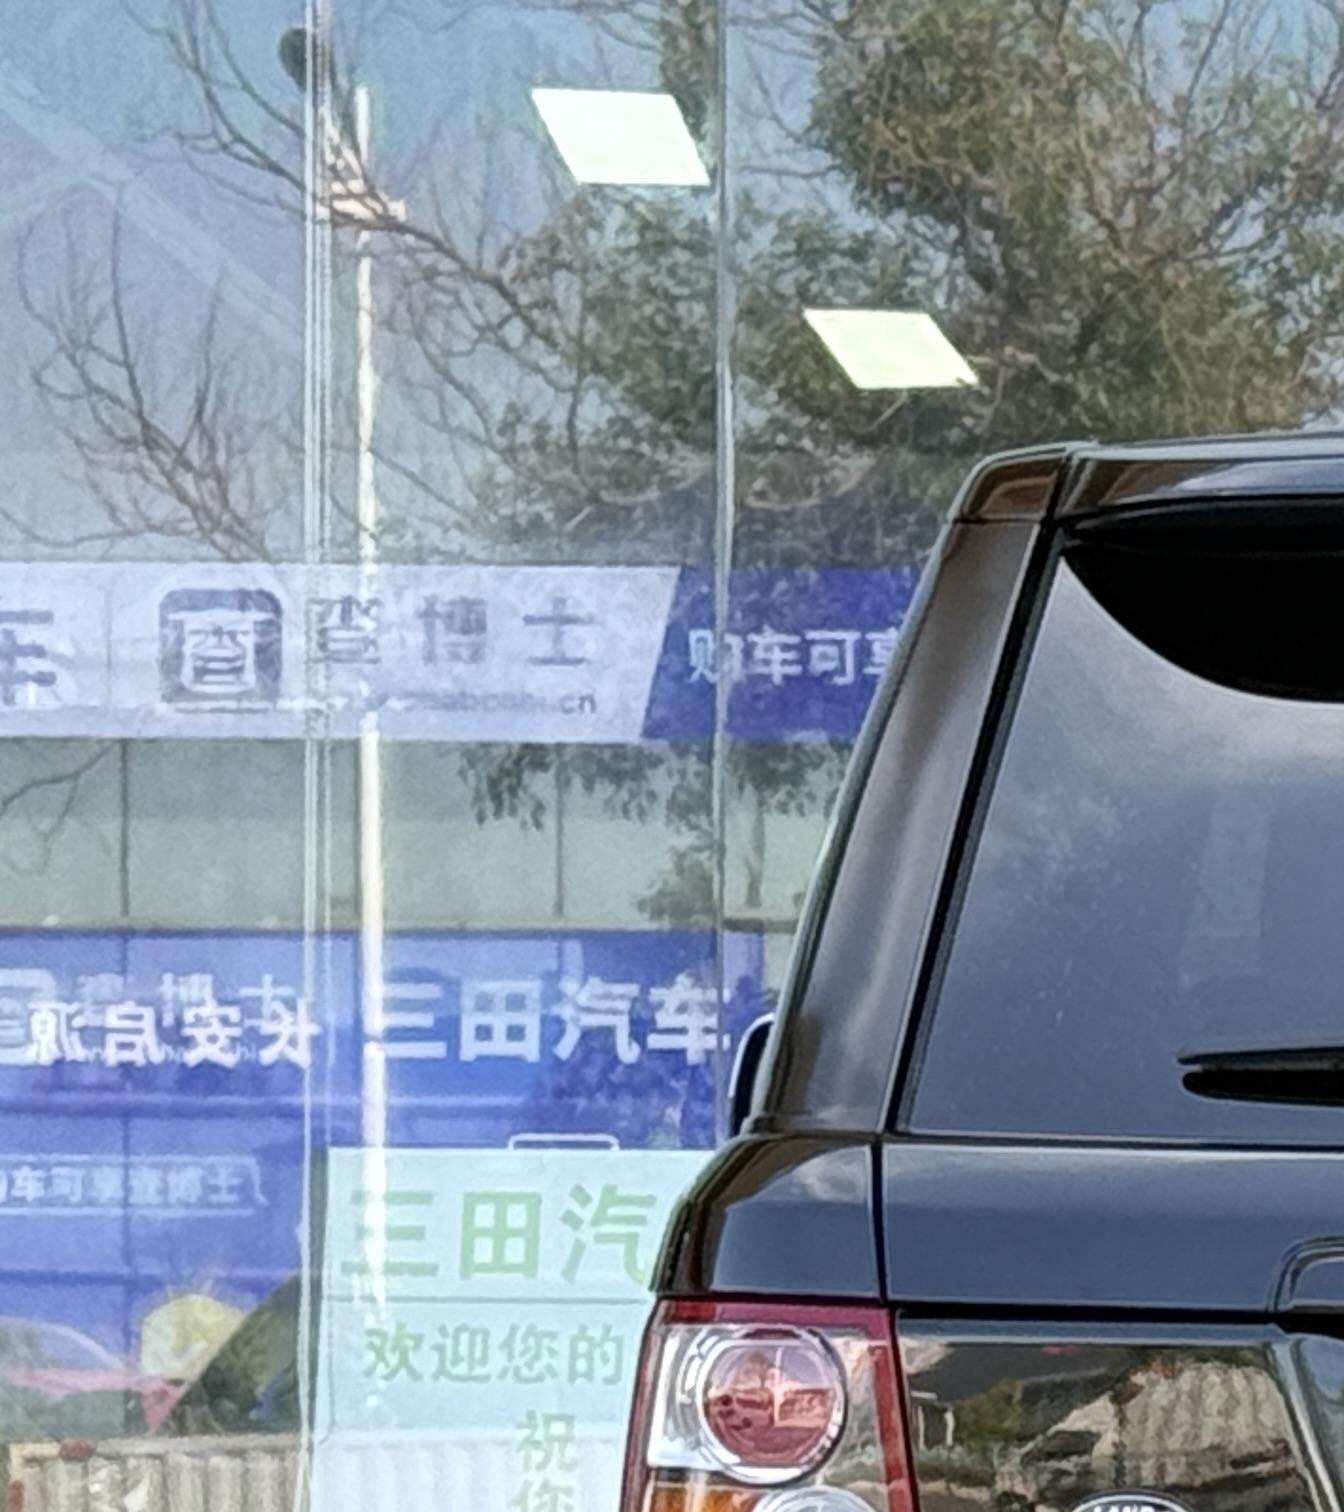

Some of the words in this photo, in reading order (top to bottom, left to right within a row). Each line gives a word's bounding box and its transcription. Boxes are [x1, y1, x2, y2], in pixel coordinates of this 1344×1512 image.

[363, 972, 732, 1068] 三田汽车
[362, 1323, 625, 1388] 欢迎您的
